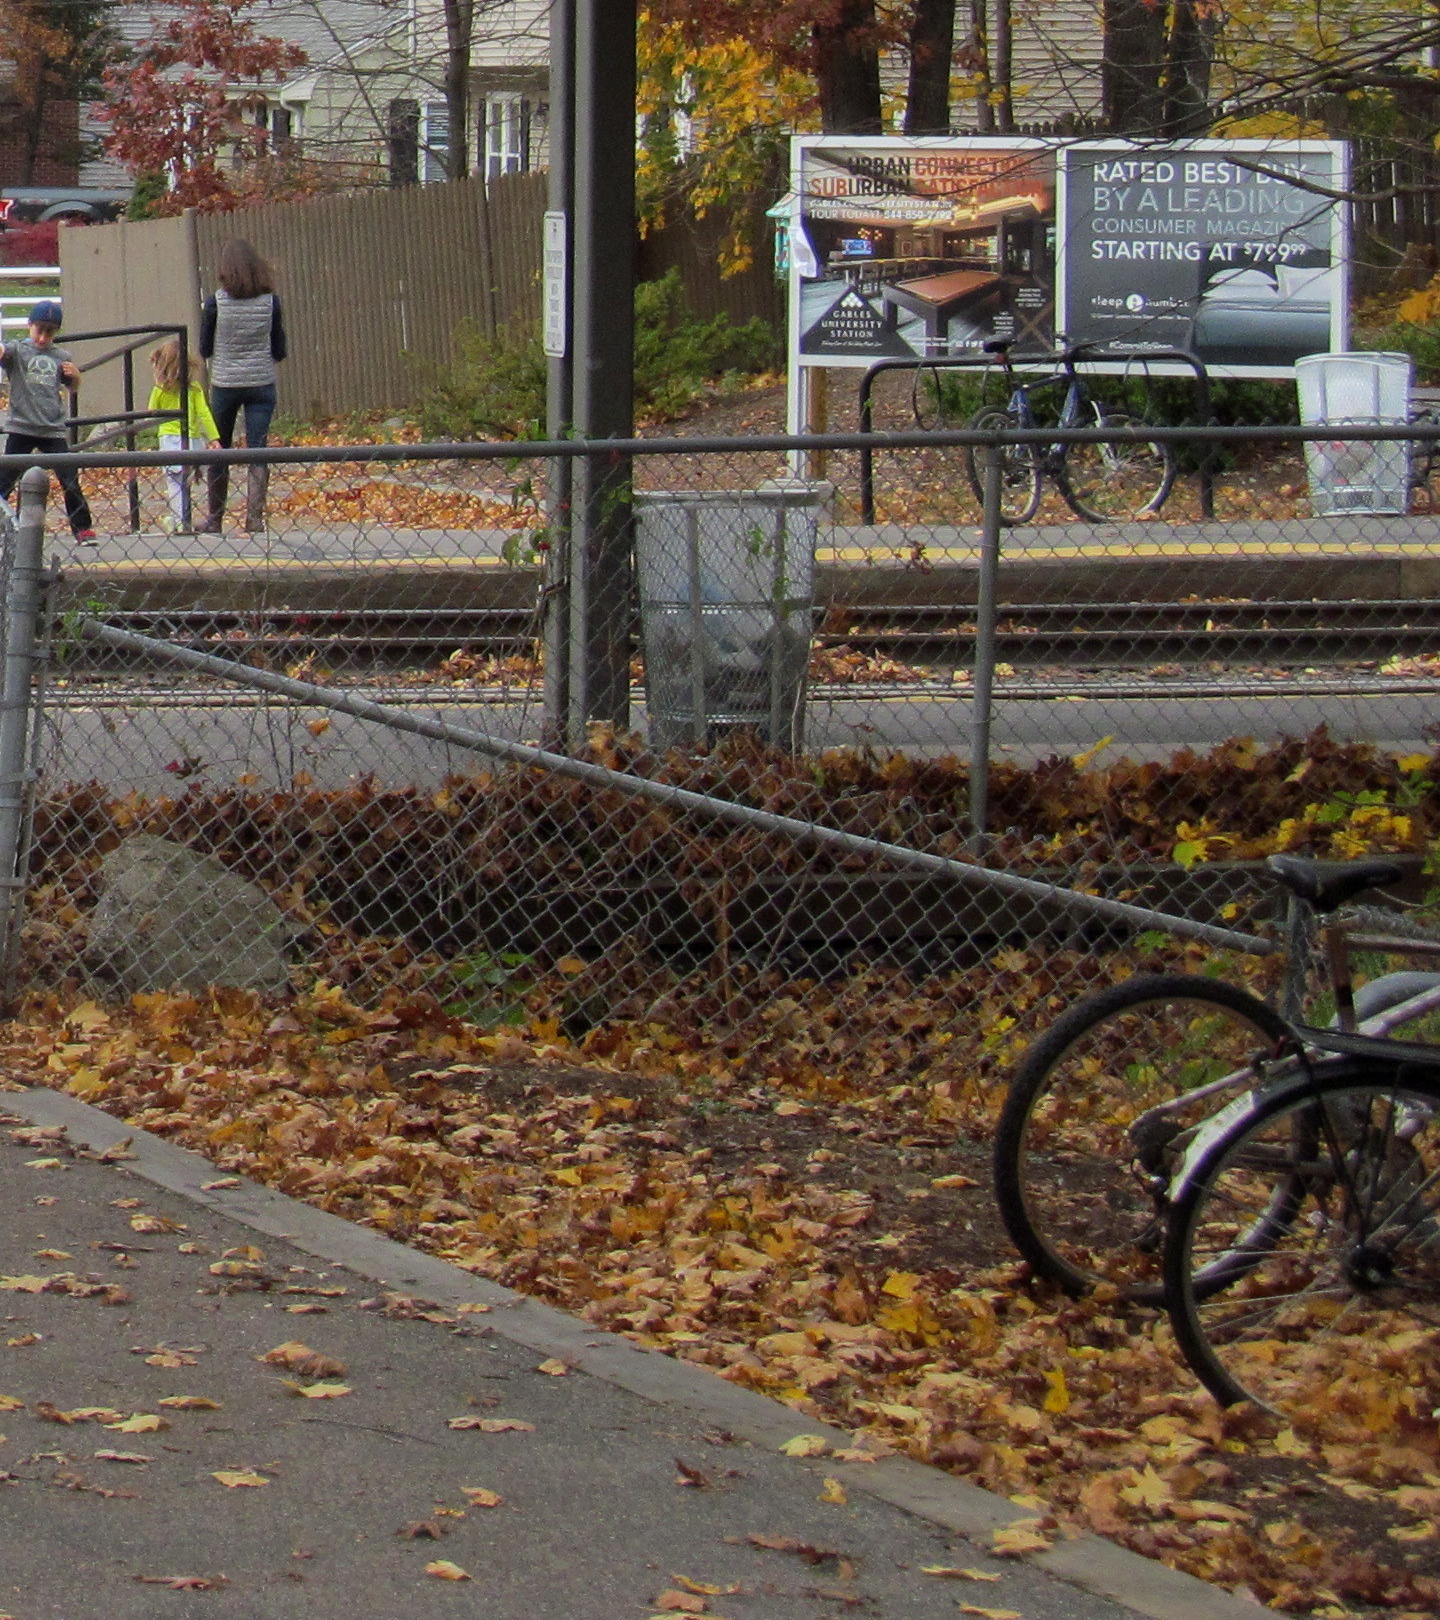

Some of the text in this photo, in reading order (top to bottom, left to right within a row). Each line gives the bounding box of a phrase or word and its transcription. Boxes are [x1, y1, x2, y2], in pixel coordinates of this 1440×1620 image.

[848, 156, 911, 176] URBAN
[1094, 162, 1307, 185] RATED BEST BUY
[811, 177, 911, 196] SUBURBAN
[1093, 187, 1304, 214] BY A LEADING
[811, 209, 838, 219] TOUR
[1091, 218, 1306, 236] CONSUMER MAGAZINE
[1092, 240, 1201, 261] STARTING
[1209, 242, 1238, 262] AT
[1090, 295, 1124, 310] sleep
[832, 310, 872, 319] GABLES
[821, 320, 883, 329] UNIVERSITY
[830, 330, 874, 339] STATION
